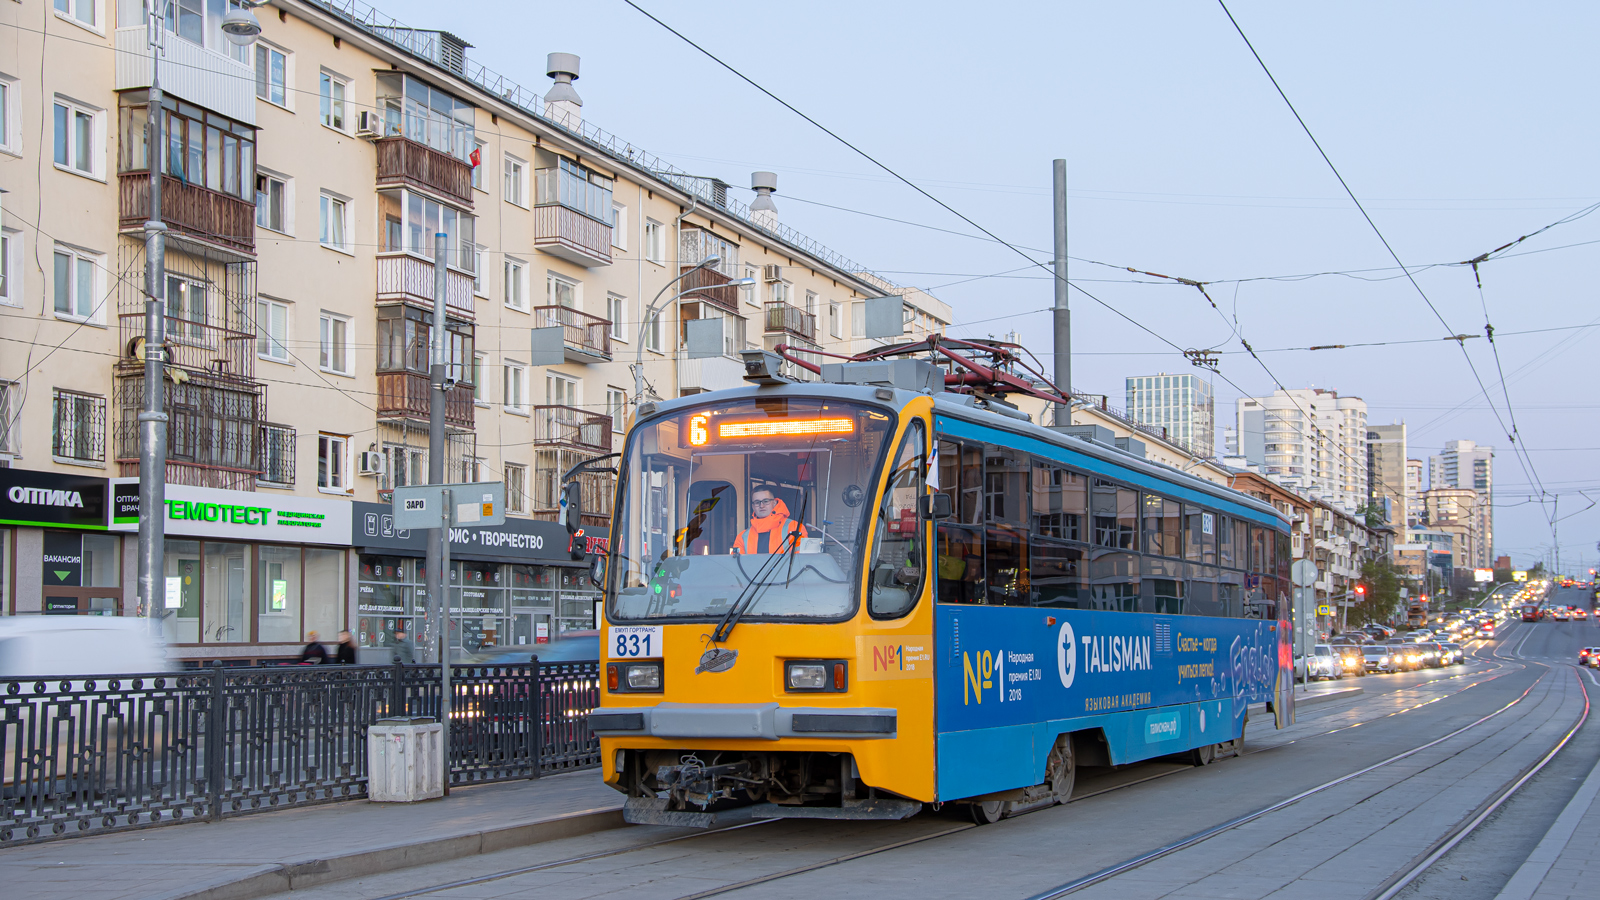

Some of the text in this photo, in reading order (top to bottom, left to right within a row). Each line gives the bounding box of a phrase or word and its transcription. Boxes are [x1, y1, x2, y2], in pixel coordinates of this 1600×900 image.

[690, 416, 707, 446] 6
[8, 486, 84, 508] ОПТИКА
[116, 495, 140, 503] ОПТИК
[406, 500, 424, 510] ЗАРО
[164, 500, 271, 525] ЕМОТЕСТ
[277, 510, 326, 519] МЕДИЦИНСКАЯ
[277, 520, 322, 528] ЛАБОРАТОРИЯ
[479, 531, 543, 550] ТВОРЧЕСТВО
[43, 555, 81, 564] ВАКАНСИЯ
[616, 634, 651, 656] 831
[905, 645, 924, 653] Народная
[1177, 632, 1198, 652] Счастье
[1203, 637, 1217, 654] когда
[873, 645, 903, 672] №1
[1008, 651, 1034, 665] Народная
[963, 649, 1004, 706] №1
[1008, 669, 1041, 684] премия E1.RU
[1178, 658, 1214, 684] учиться легко!
[1230, 629, 1275, 719] English
[1008, 689, 1022, 701] 2018
[1085, 691, 1151, 711] ЯЗЫКОВАЯ АКАДЕМИЯ
[1150, 717, 1177, 735] талисман.рф
